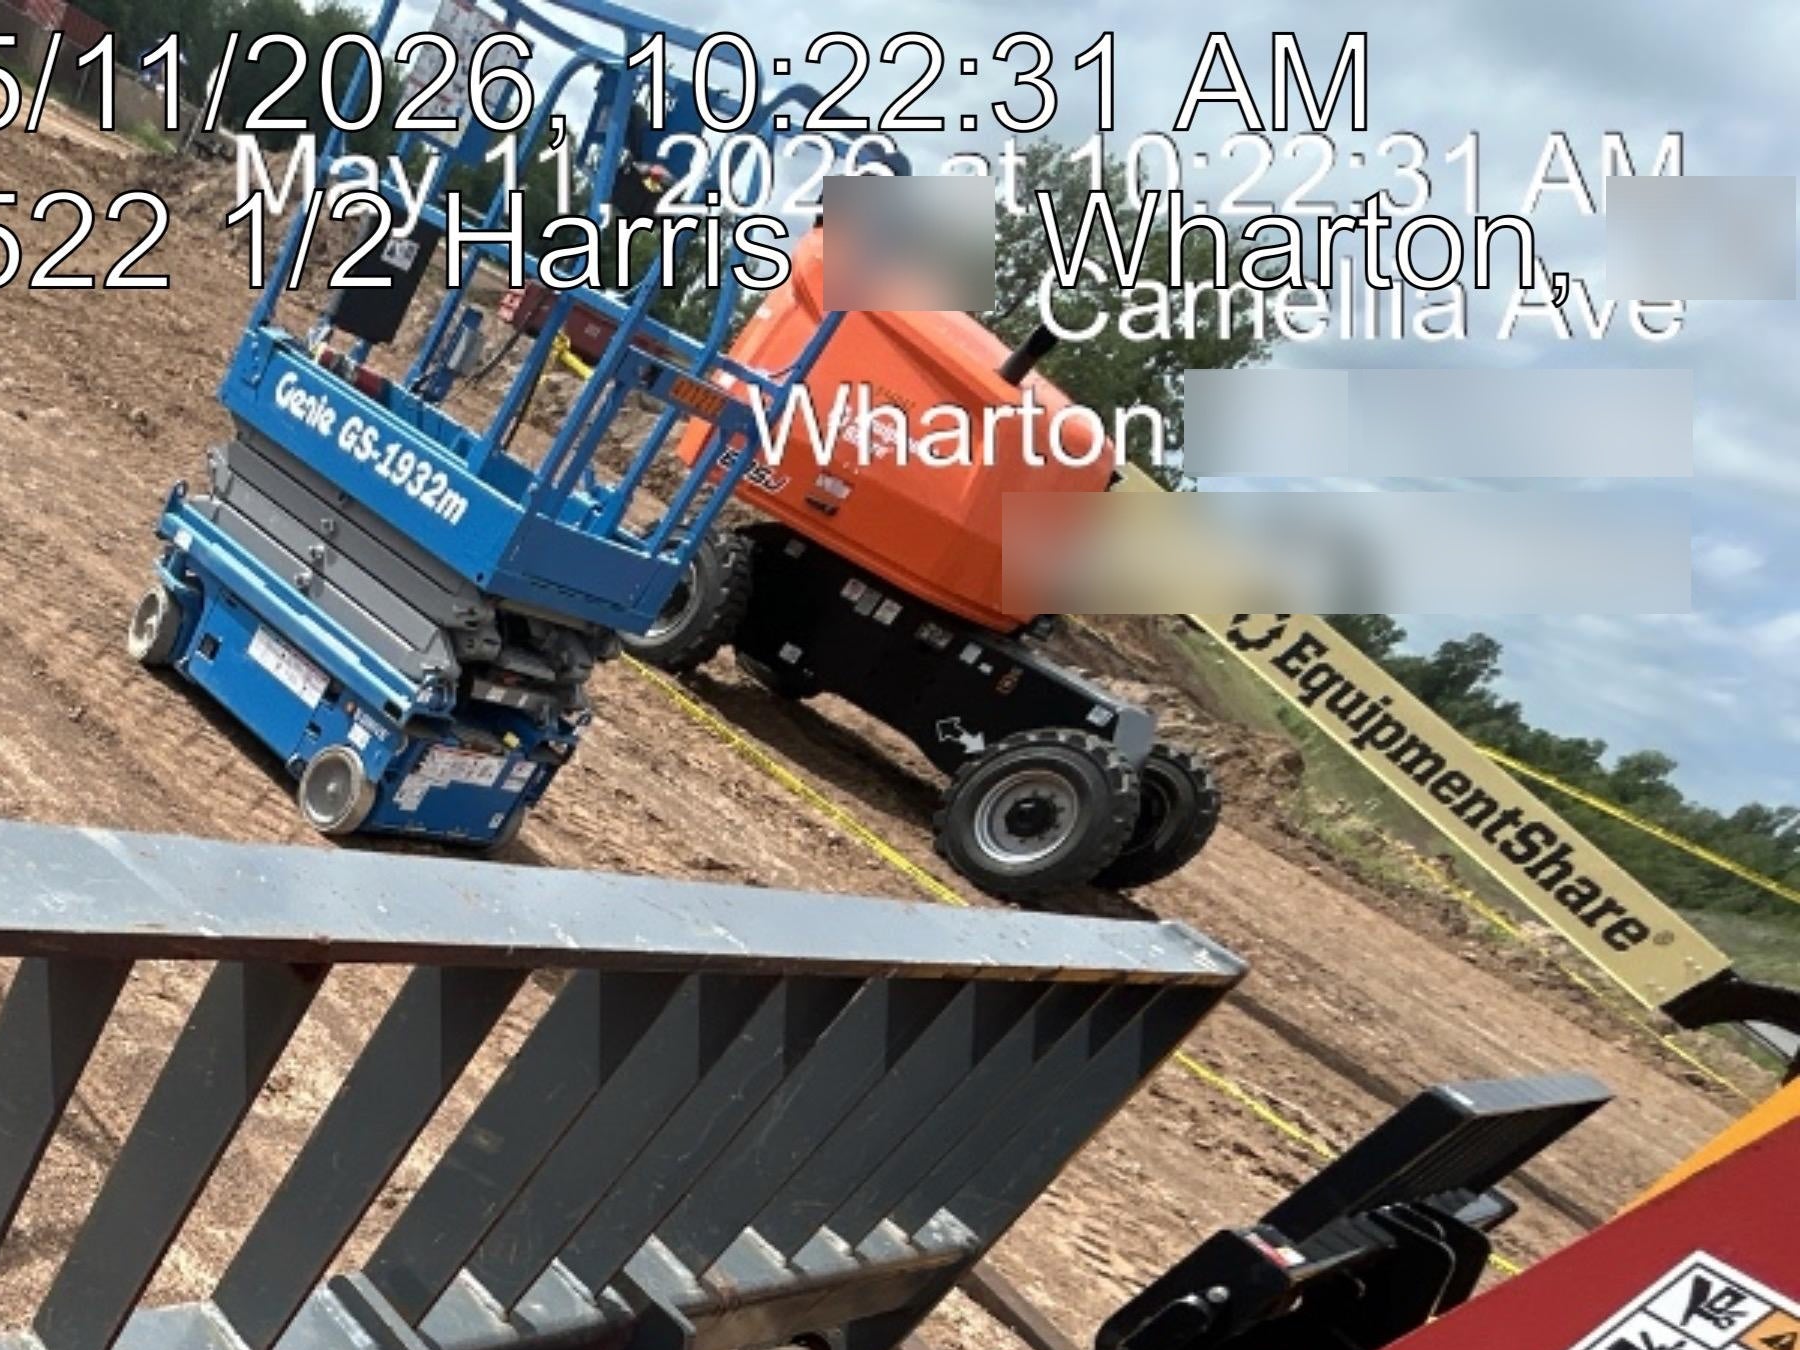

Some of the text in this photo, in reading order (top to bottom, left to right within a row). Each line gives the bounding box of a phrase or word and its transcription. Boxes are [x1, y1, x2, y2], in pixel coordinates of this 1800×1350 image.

[275, 371, 470, 526] Genie GS-1932m
[1269, 630, 1650, 952] EquipmentShare
